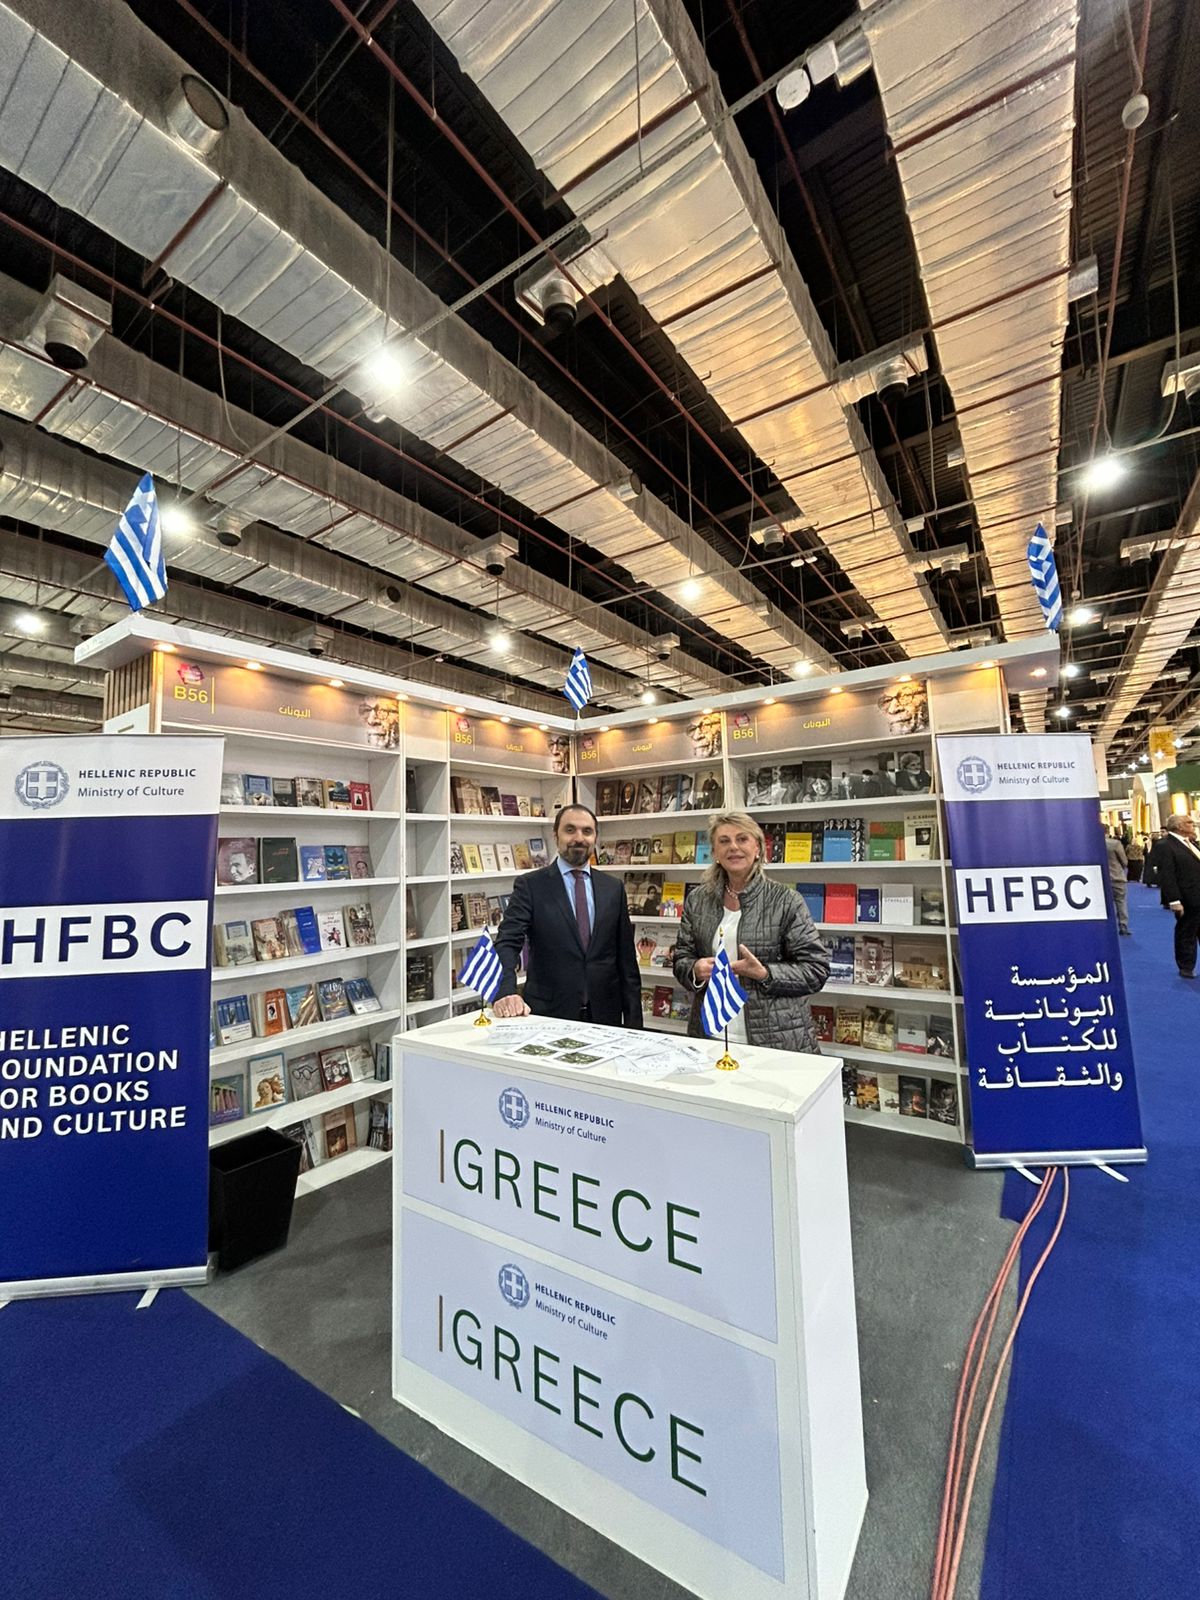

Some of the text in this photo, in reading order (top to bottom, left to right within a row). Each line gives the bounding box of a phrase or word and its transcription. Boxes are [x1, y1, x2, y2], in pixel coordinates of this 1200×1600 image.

[174, 686, 208, 704] B56
[454, 733, 472, 745] B56
[733, 728, 754, 740] B56
[581, 750, 597, 760] B56
[997, 761, 1076, 770] HELLENIC REPUBLIC
[79, 769, 196, 778] HELLENIC REPUBLIC
[999, 775, 1070, 786] Ministry of Culture
[78, 786, 184, 798] Ministry of Culture
[965, 874, 1091, 913] HFBC
[1, 912, 192, 965] HFBC
[1011, 962, 1110, 993] المؤسسة
[984, 994, 1114, 1026] اليونانية
[997, 1026, 1118, 1063] للكتاب
[0, 1049, 178, 1080] OUNDATION
[978, 1062, 1124, 1092] والثقافة
[0, 1080, 149, 1109] OR BOOKS
[0, 1105, 187, 1139] ND CULTURE
[536, 1102, 614, 1128] HELLENIC REPUBLIC
[536, 1117, 606, 1143] Ministry of Culture
[536, 1283, 616, 1324] HELLENIC REPUBLIC
[536, 1300, 607, 1339] Ministry of Culture
